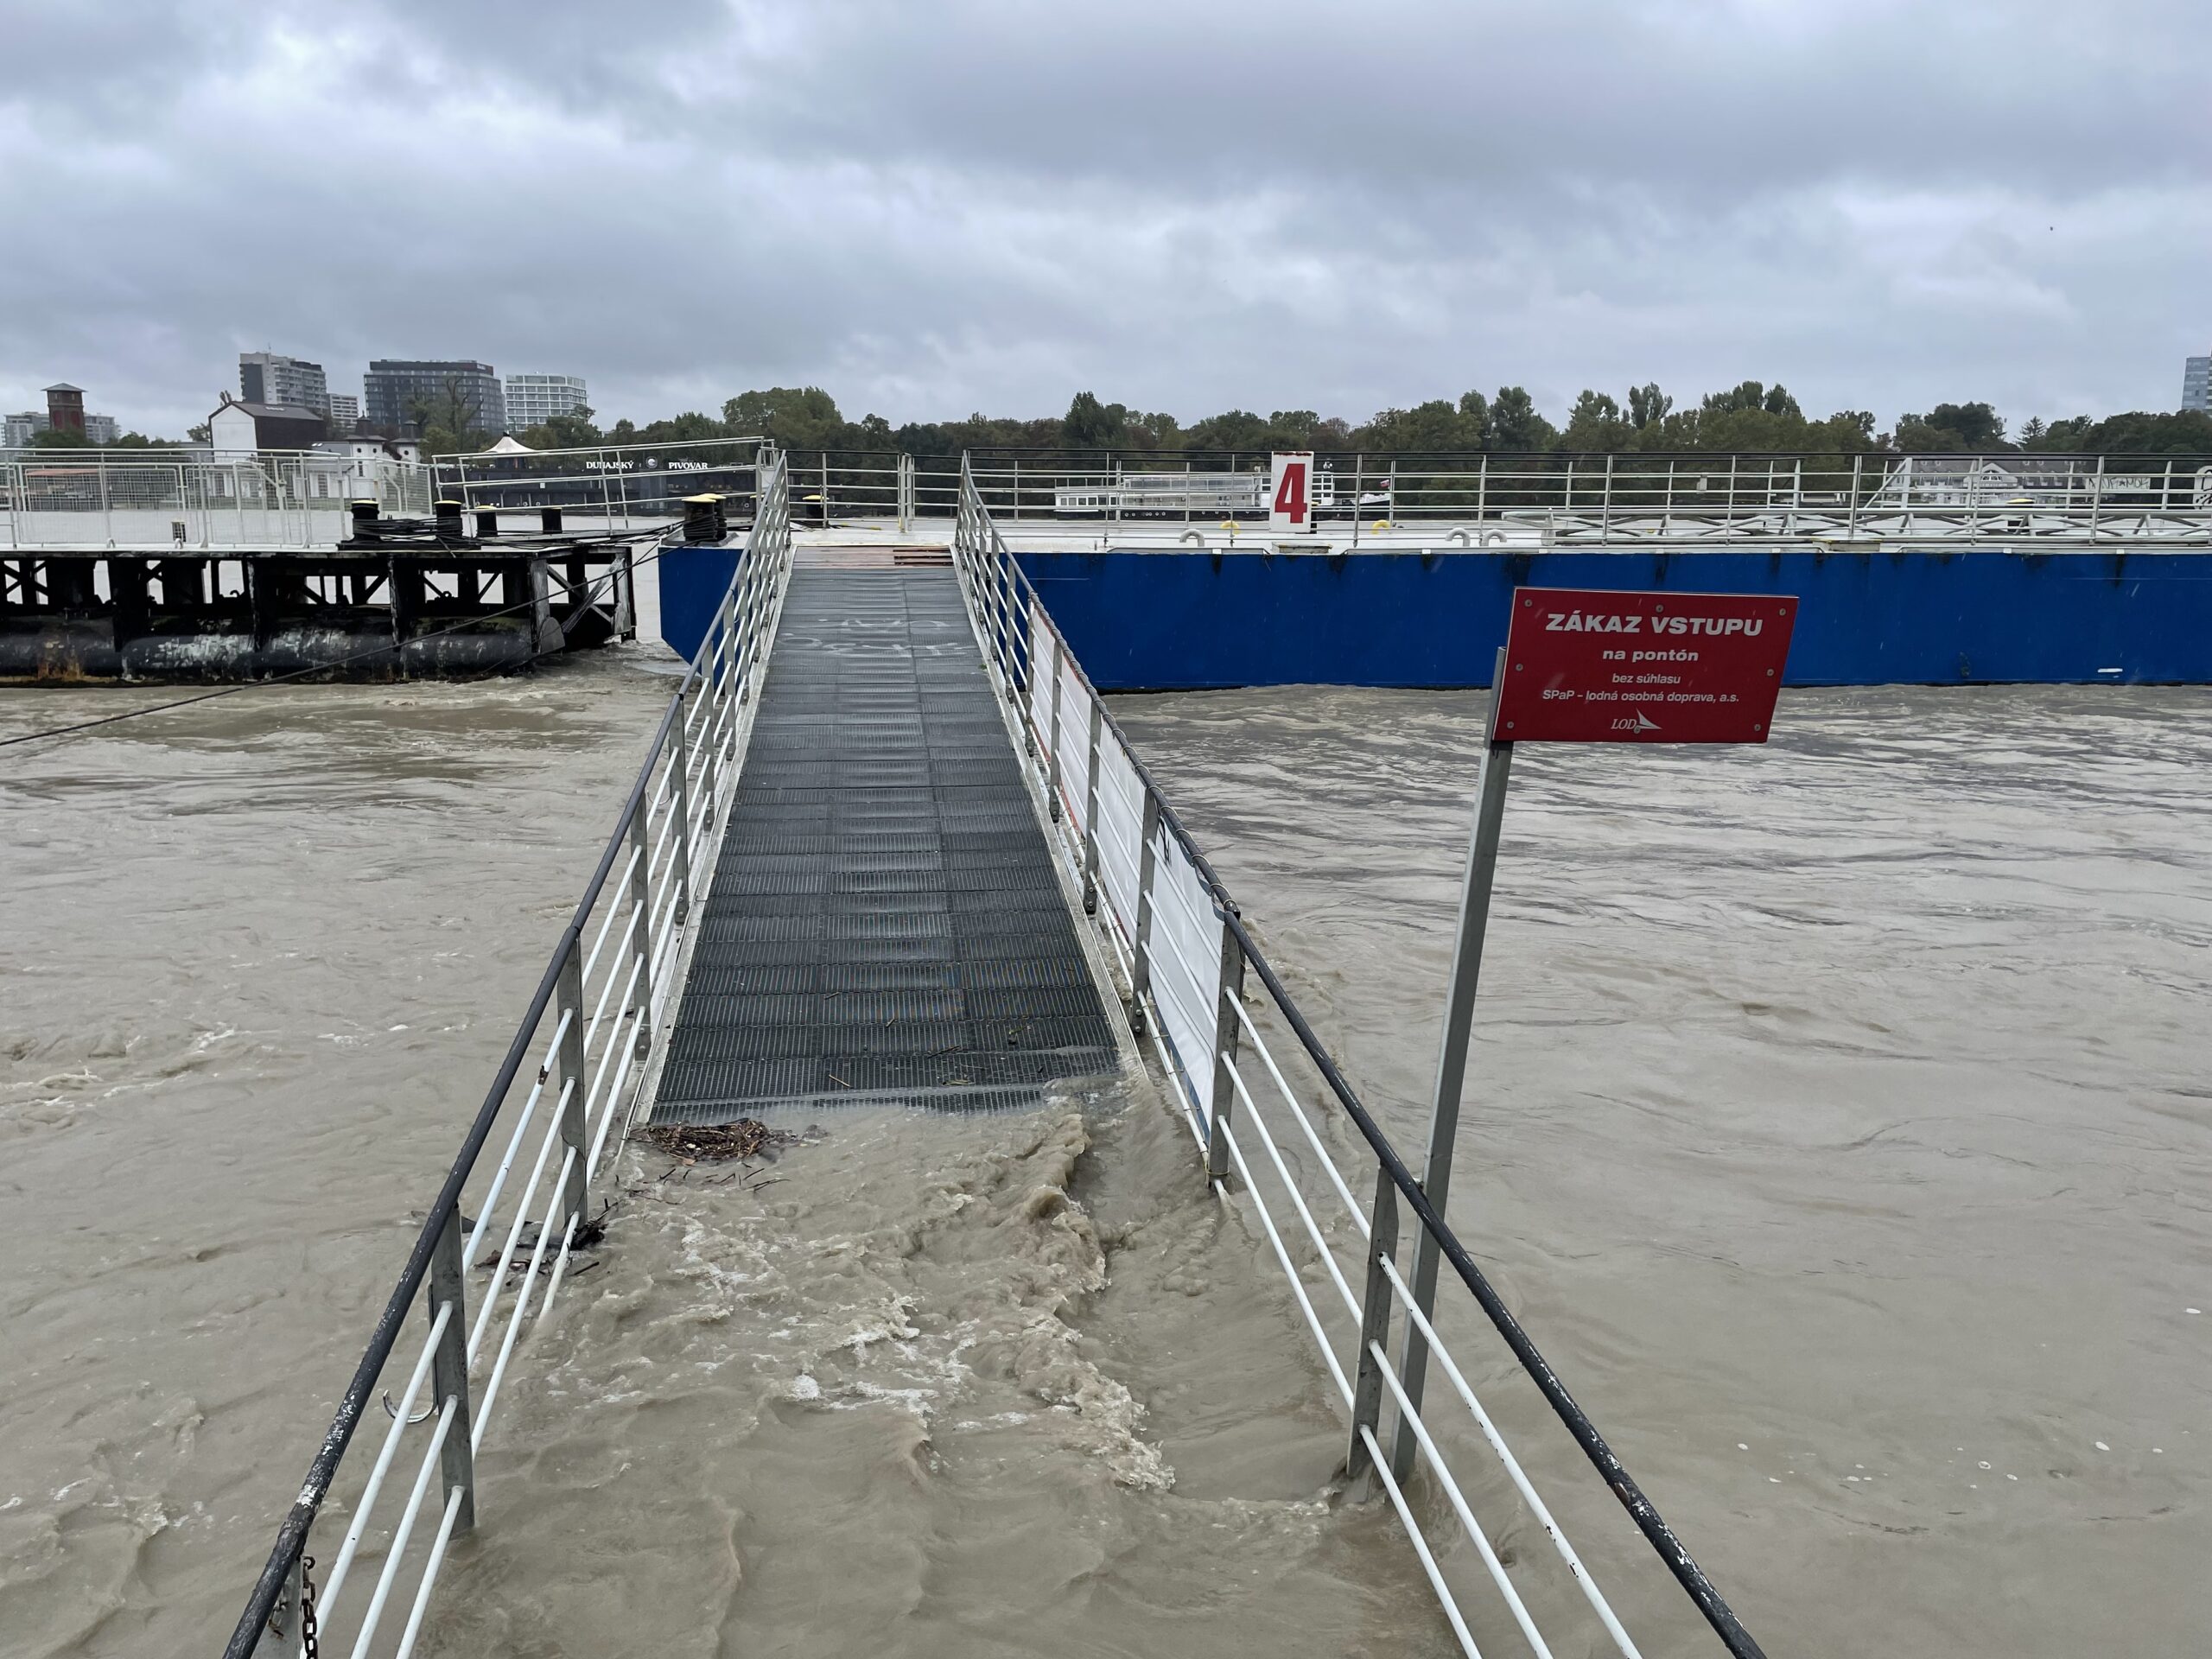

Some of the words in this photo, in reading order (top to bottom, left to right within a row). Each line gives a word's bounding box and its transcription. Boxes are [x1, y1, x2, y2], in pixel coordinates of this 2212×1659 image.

[1274, 463, 1307, 524] 4
[1545, 610, 1643, 632] ZÁKAZ
[1651, 616, 1763, 636] VSTUPU
[1603, 650, 1626, 660] na
[1632, 650, 1699, 663] pontón
[1612, 673, 1633, 683] bez
[1636, 673, 1681, 684] súhlasu
[1542, 690, 1575, 700] SPaP
[1585, 690, 1618, 701] lodná
[1621, 691, 1664, 702] osobná
[1667, 692, 1716, 703] doprava,
[1719, 694, 1739, 702] a.s.
[1611, 719, 1637, 729] LOD
